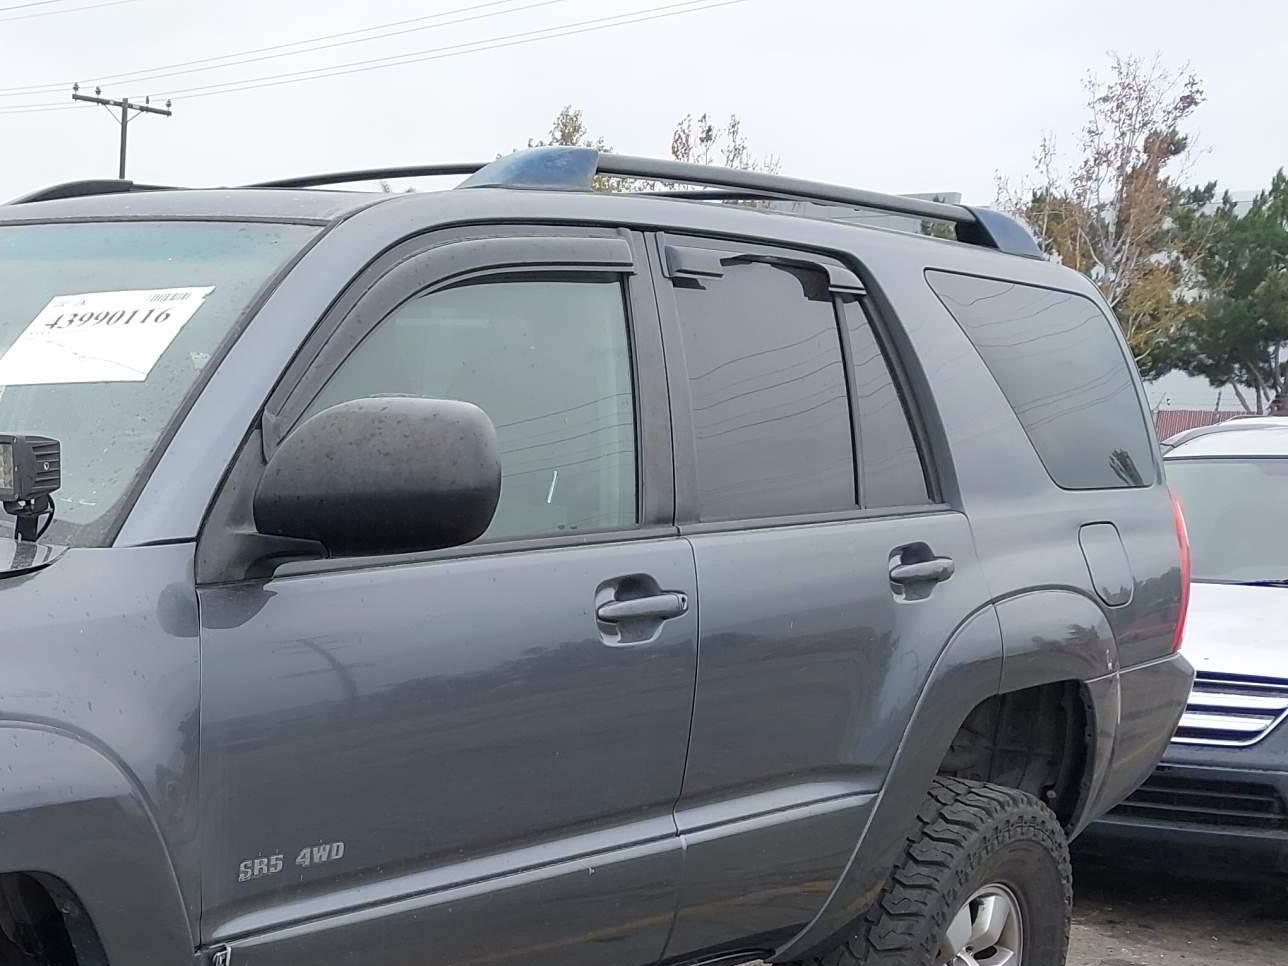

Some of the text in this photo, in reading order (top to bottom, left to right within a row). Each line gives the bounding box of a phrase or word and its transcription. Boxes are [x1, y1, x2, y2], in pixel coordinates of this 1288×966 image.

[44, 307, 174, 329] 43990116
[238, 842, 345, 882] SR5 4WD
